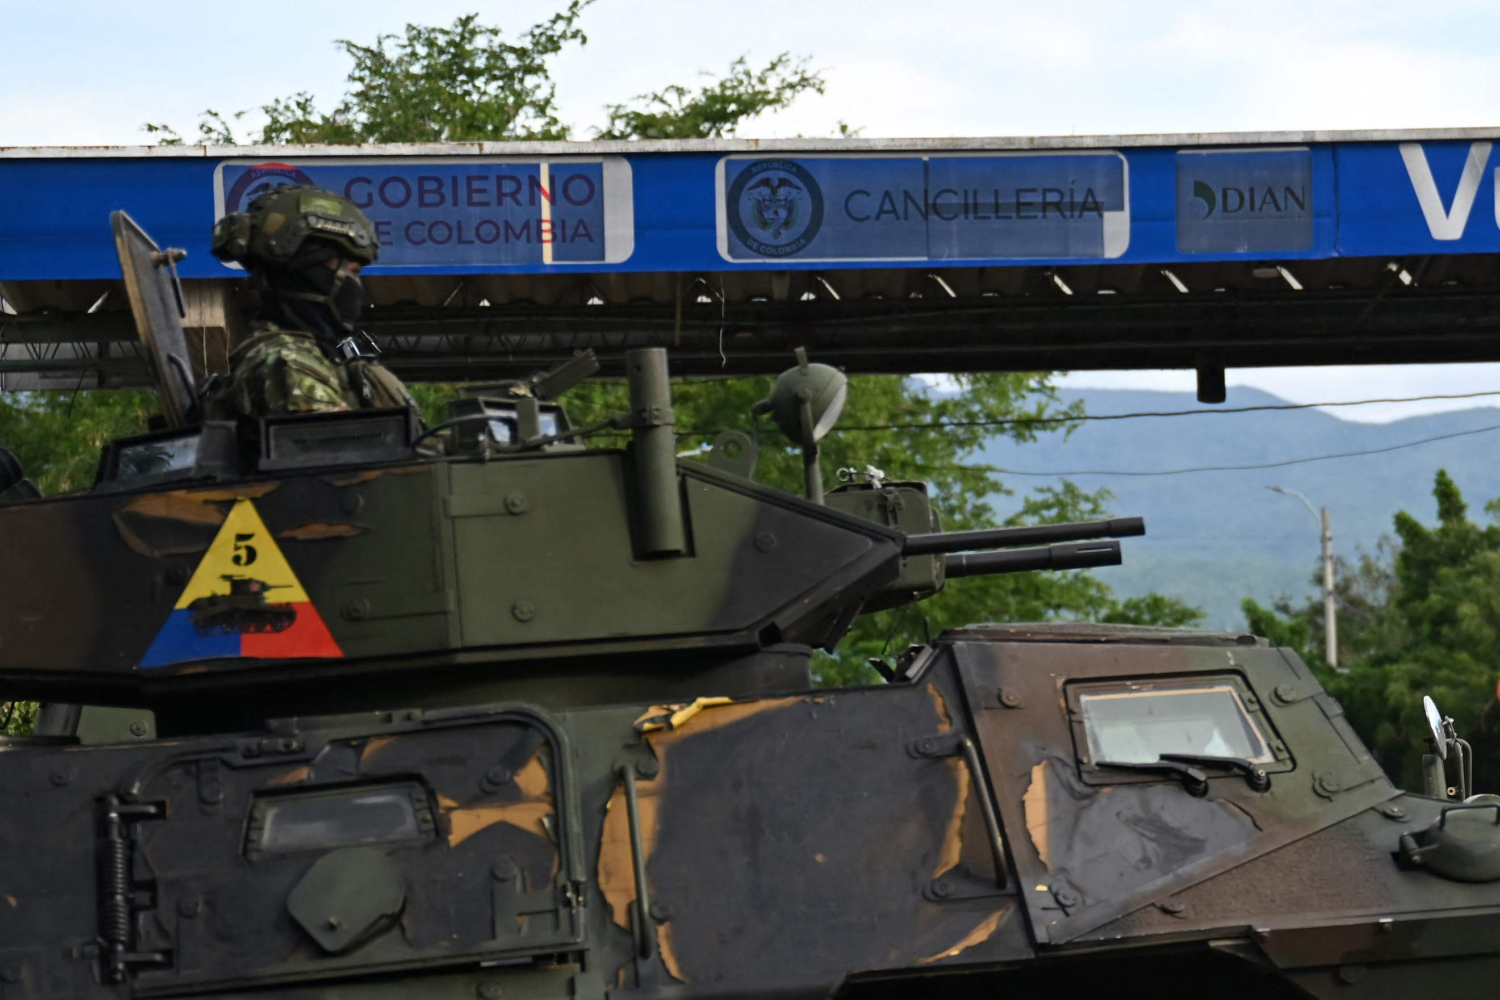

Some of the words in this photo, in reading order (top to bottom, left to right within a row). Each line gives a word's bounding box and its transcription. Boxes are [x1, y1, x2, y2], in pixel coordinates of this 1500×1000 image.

[343, 173, 596, 210] GOBIERNO
[843, 180, 1104, 223] CANCILLERÍA
[1221, 185, 1306, 214] DIAN
[405, 218, 594, 246] COLOMBIA
[231, 533, 258, 567] 5
